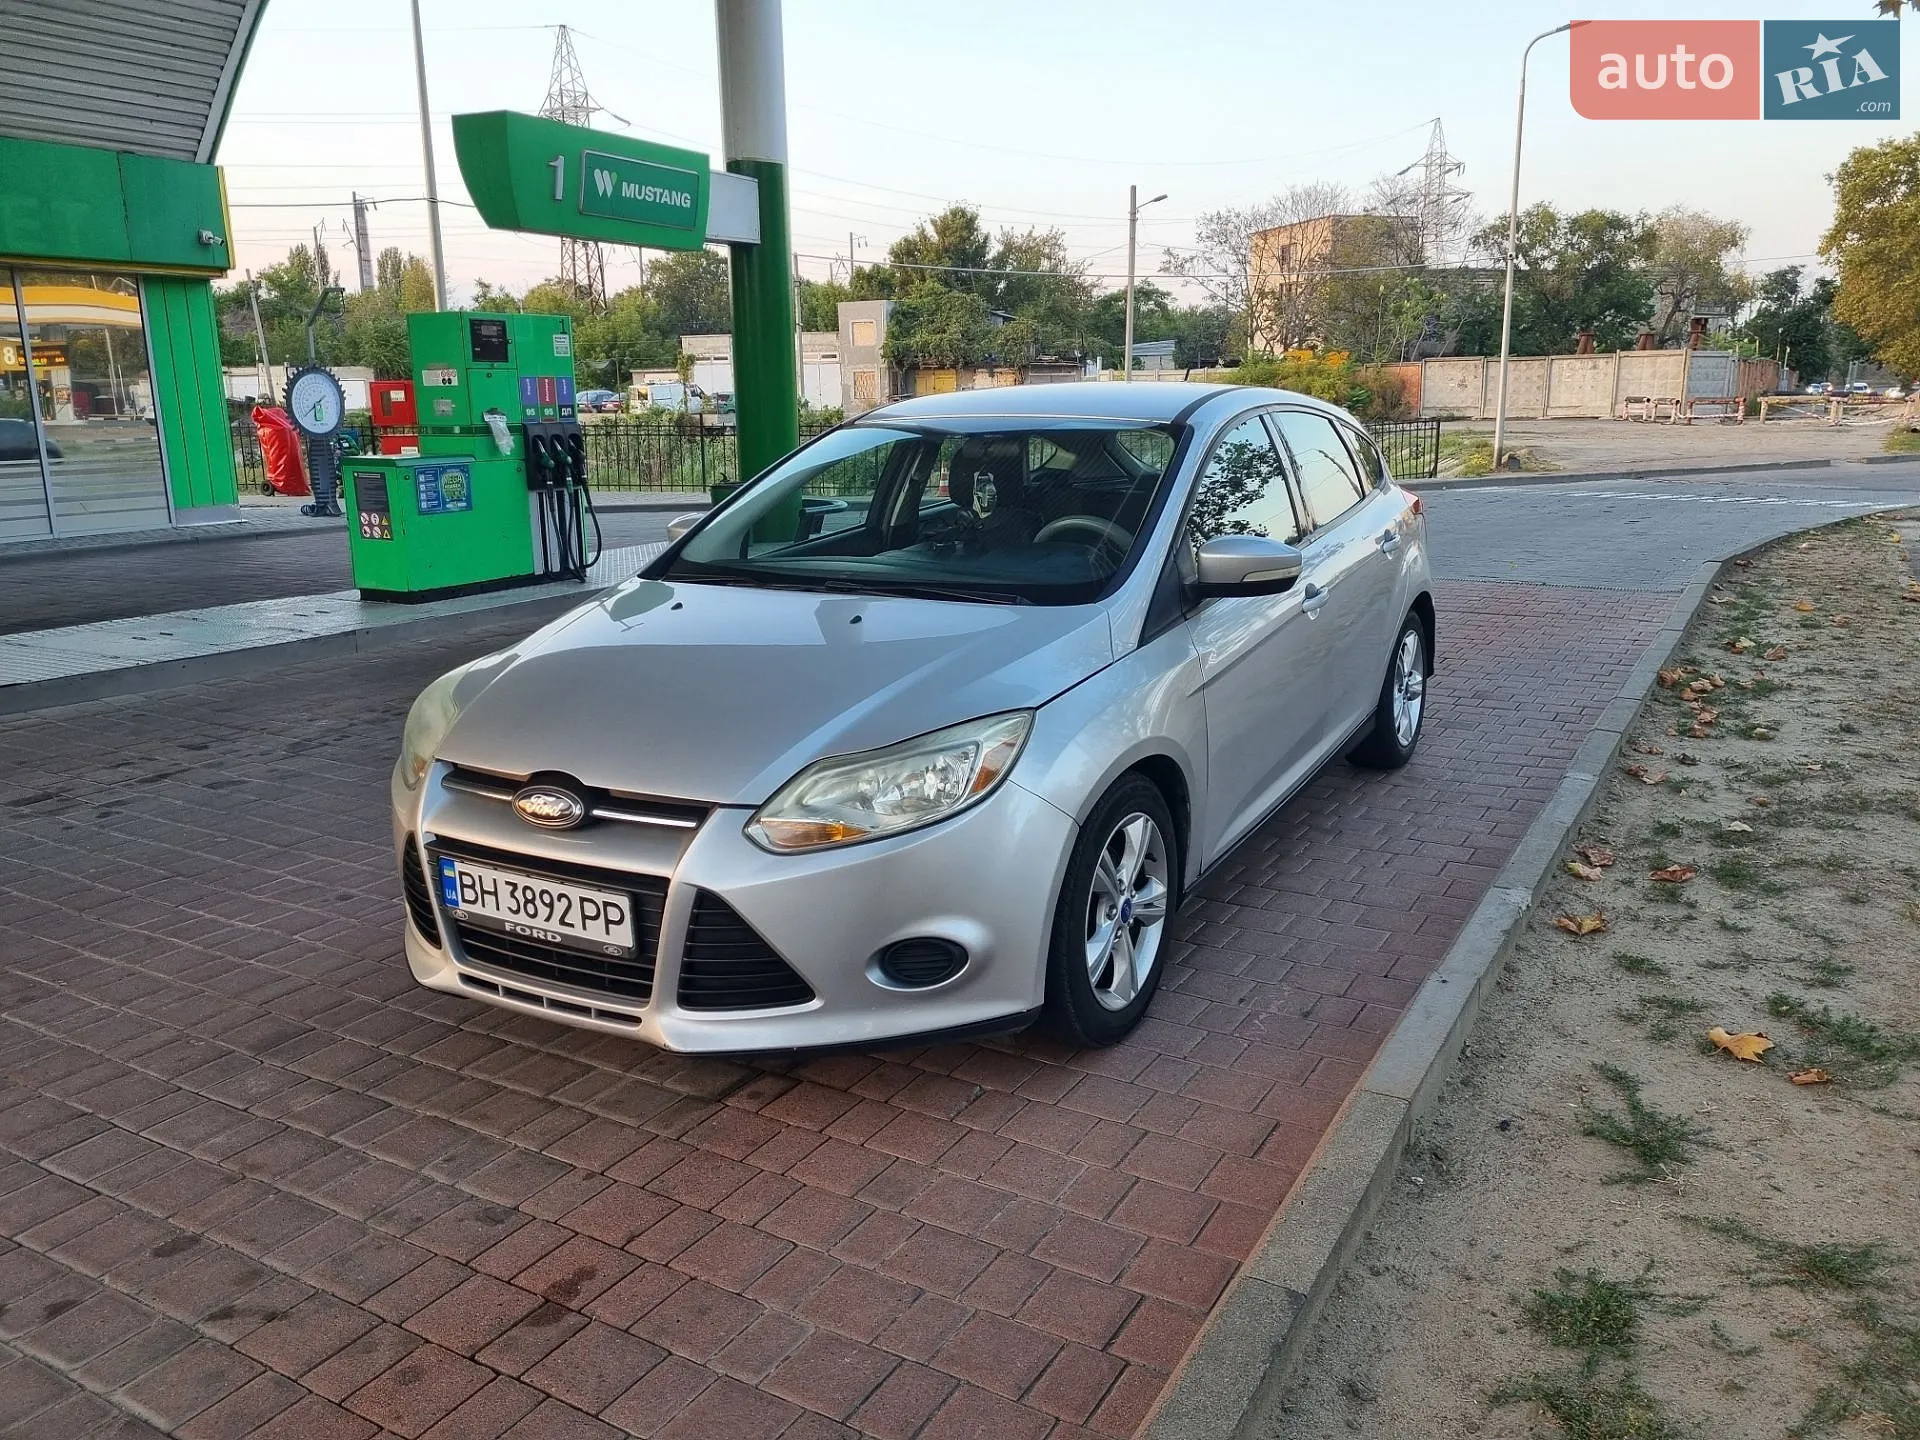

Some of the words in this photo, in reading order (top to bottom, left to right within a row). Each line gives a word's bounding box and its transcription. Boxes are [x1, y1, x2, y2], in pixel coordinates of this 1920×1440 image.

[546, 155, 565, 201] 1
[621, 181, 692, 208] MUSTANG
[519, 794, 565, 817] Ford
[445, 888, 458, 901] UA
[504, 880, 575, 929] 3892
[504, 921, 563, 944] FORD
